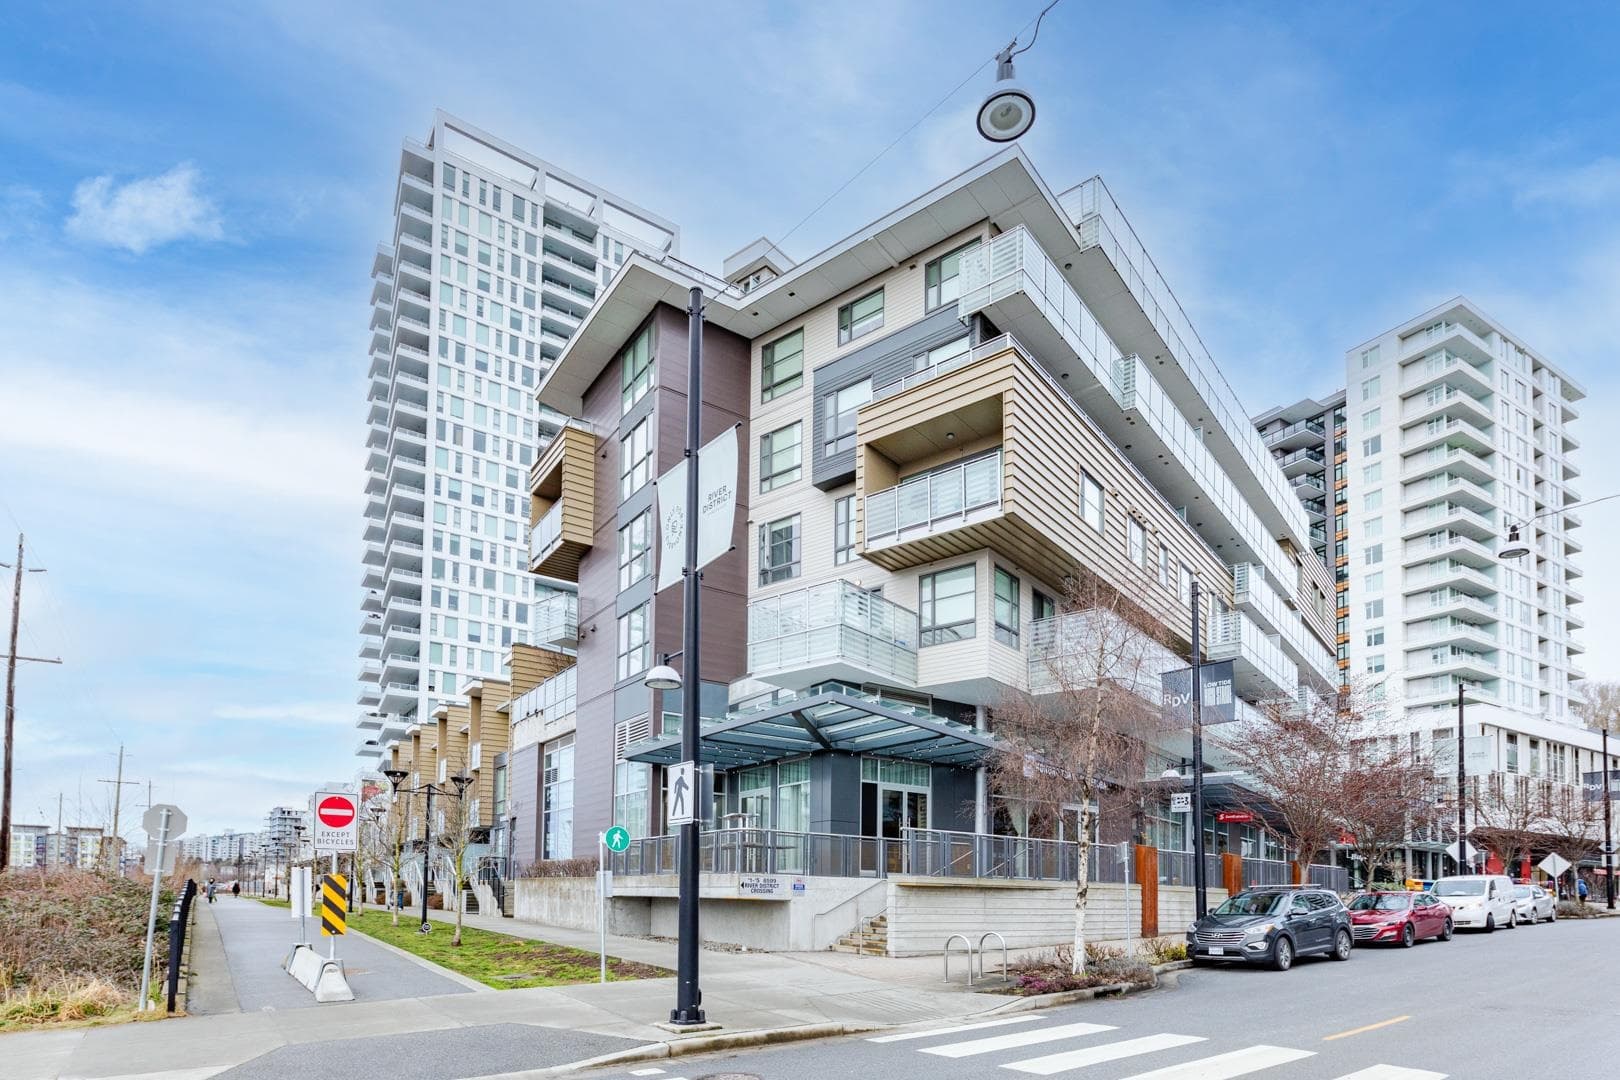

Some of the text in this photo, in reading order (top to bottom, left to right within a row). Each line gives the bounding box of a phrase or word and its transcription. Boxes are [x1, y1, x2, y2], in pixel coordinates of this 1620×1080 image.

[707, 485, 728, 502] RIVER
[702, 491, 732, 514] DISTRICT
[1203, 681, 1217, 689] LOW
[1163, 692, 1190, 708] RDV
